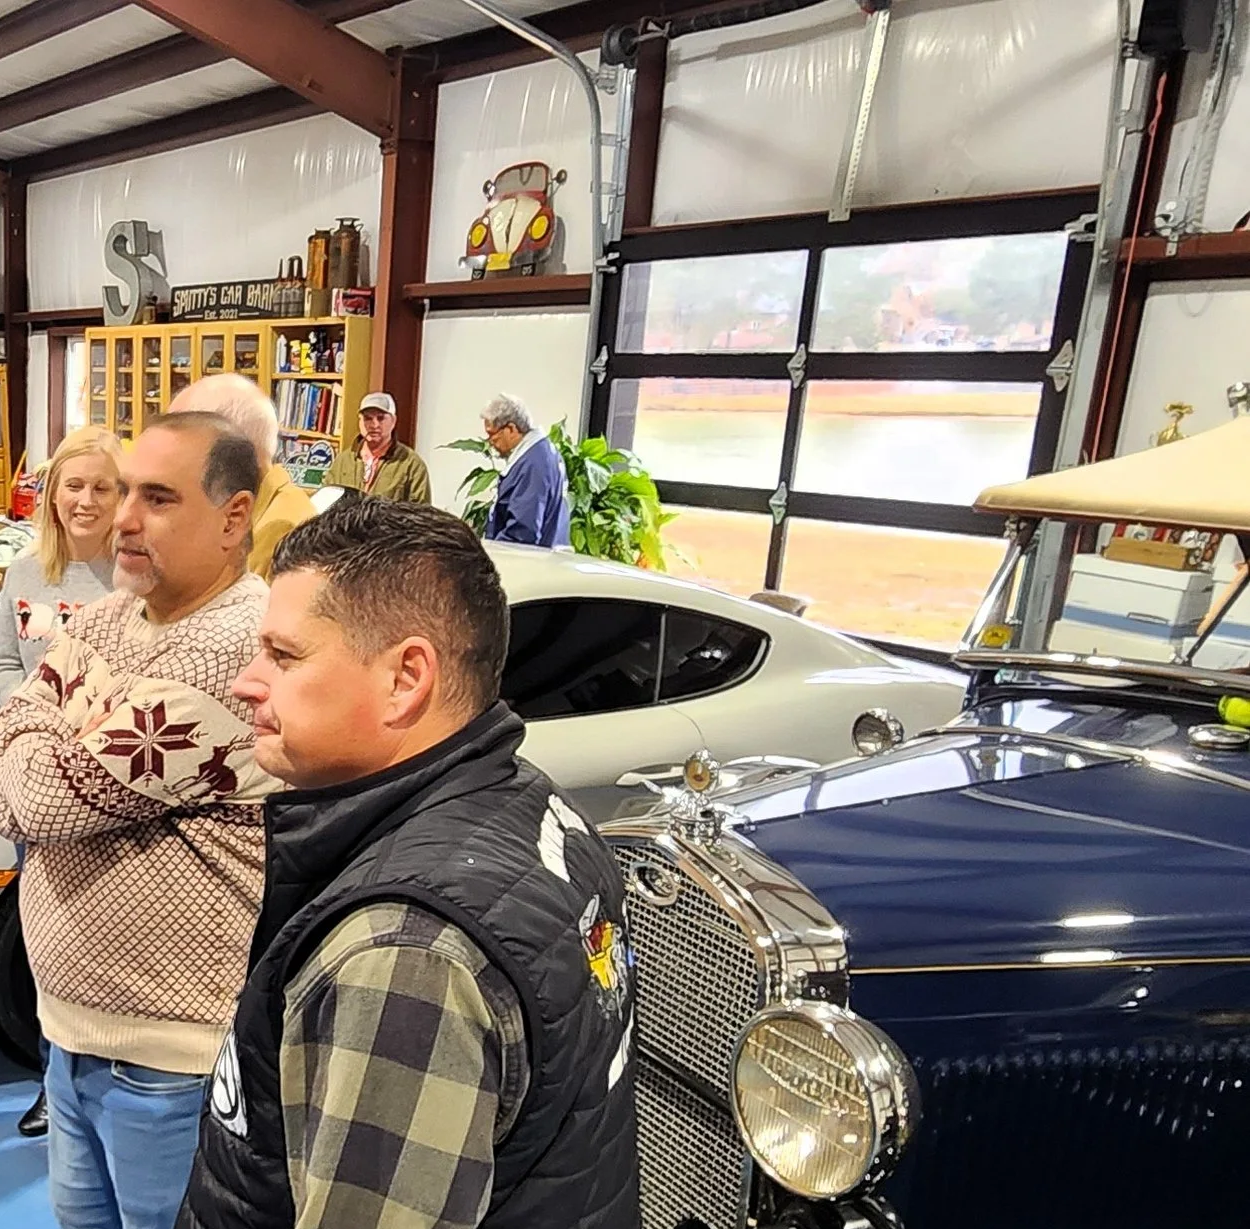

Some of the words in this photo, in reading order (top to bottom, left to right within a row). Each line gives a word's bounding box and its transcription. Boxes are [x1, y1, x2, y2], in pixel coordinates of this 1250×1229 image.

[173, 287, 218, 317] SMITTY'S
[220, 285, 243, 305] CAR
[204, 310, 218, 319] Est.
[220, 308, 239, 319] 2021
